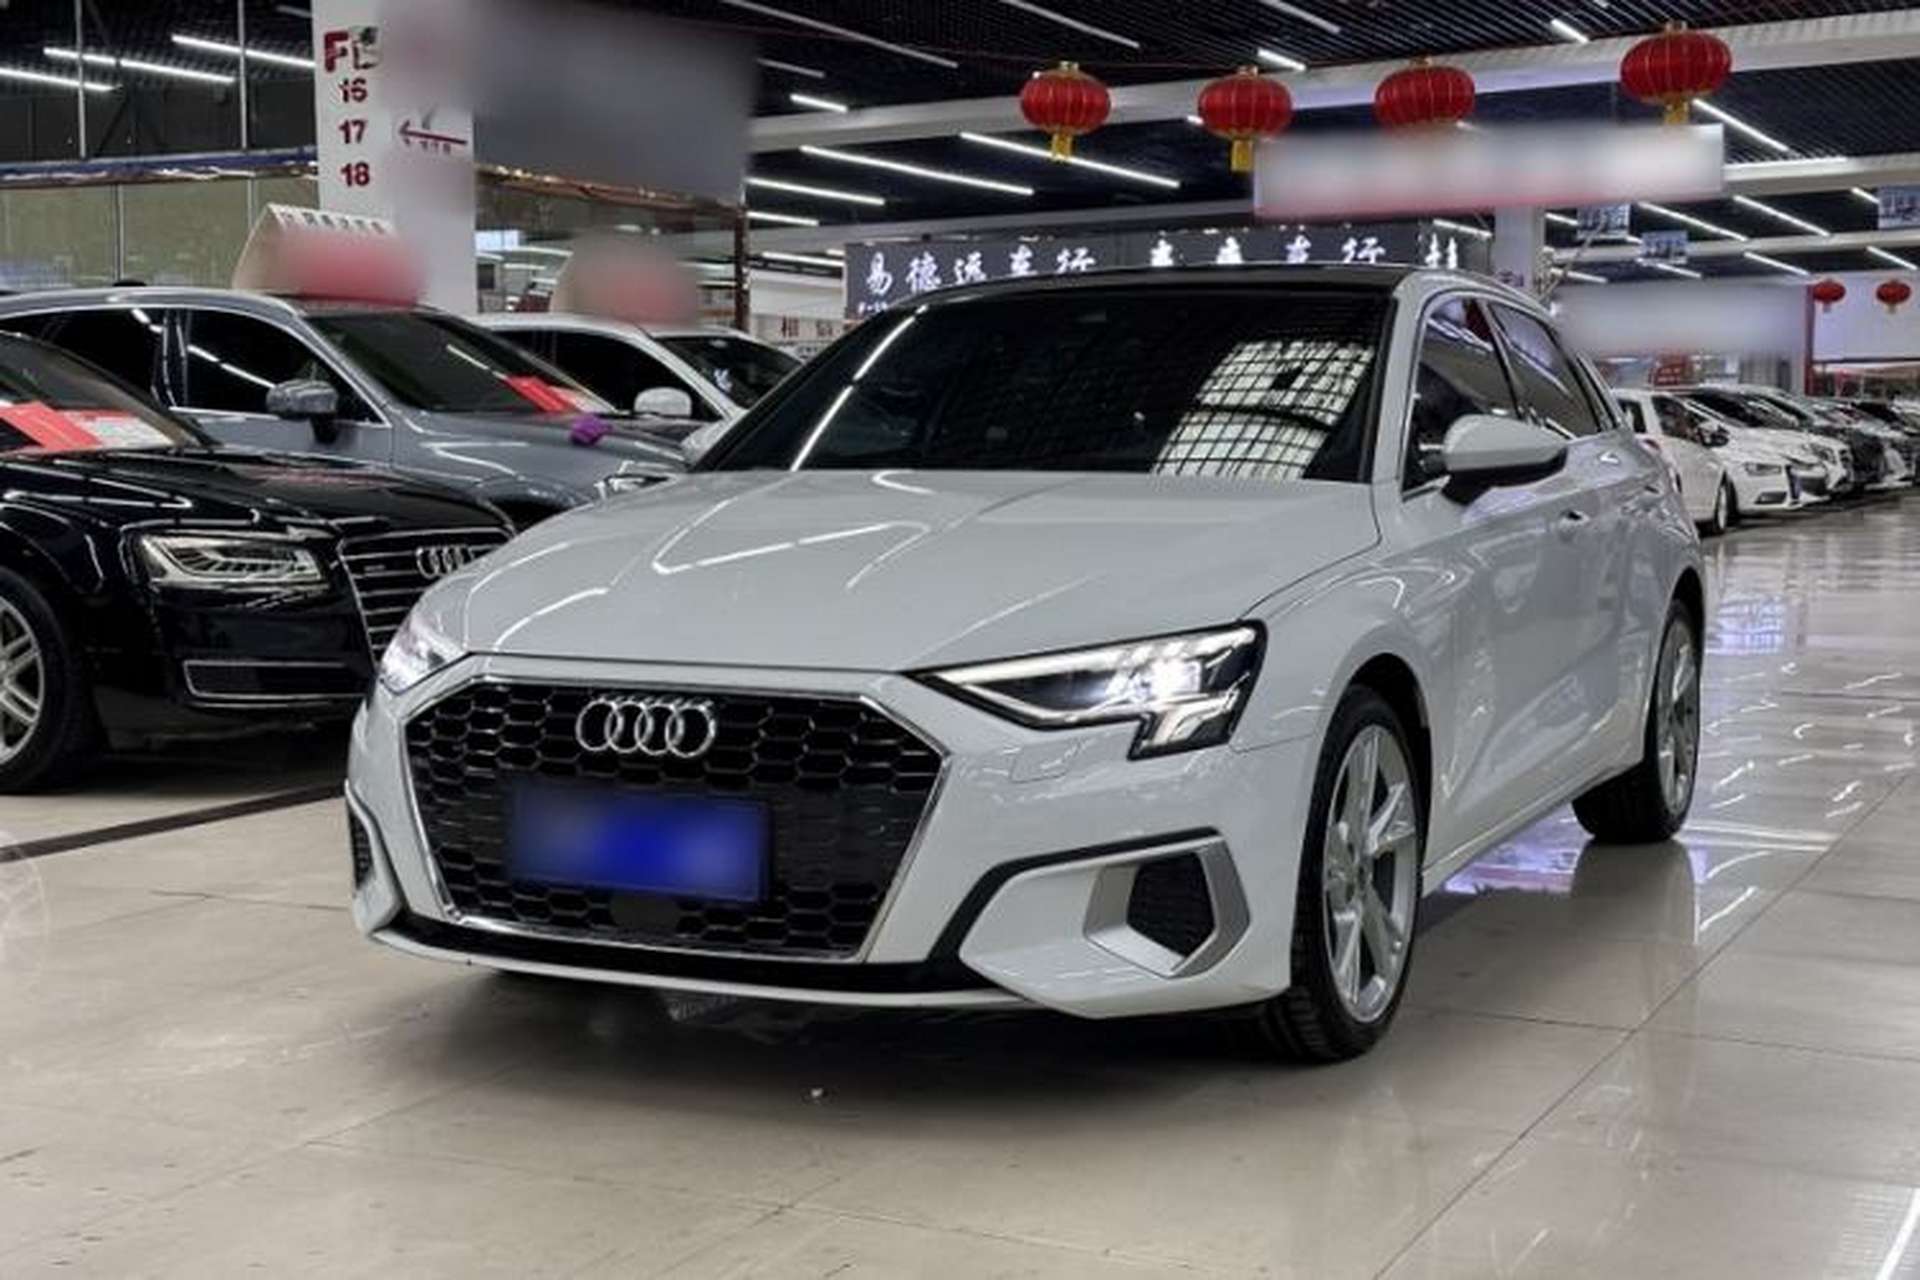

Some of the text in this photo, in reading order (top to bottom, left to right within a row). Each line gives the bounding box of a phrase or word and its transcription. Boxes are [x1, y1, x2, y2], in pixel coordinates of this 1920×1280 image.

[338, 77, 368, 103] 16
[338, 118, 368, 145] 17
[340, 161, 371, 188] 18
